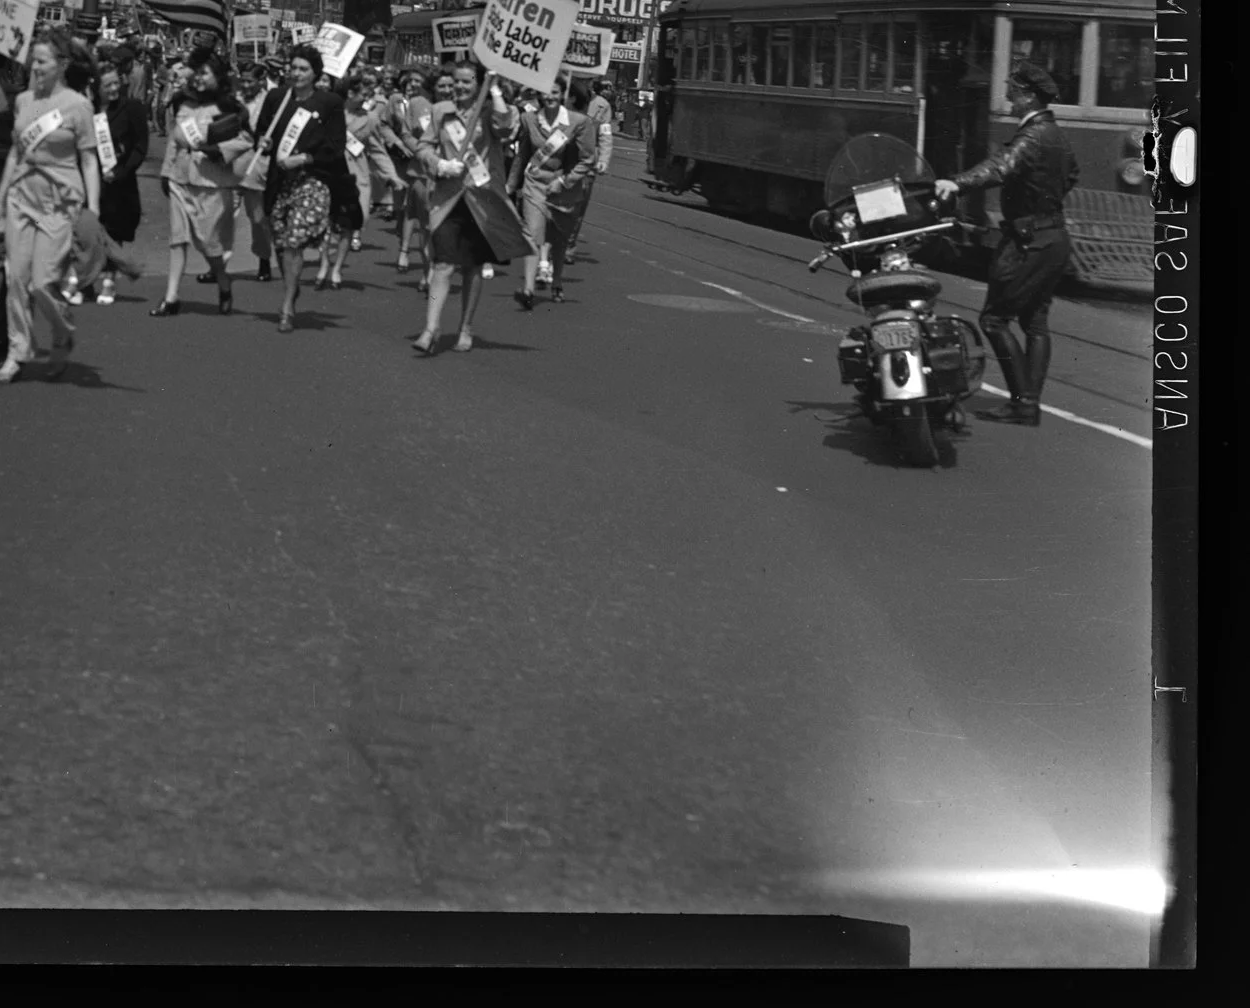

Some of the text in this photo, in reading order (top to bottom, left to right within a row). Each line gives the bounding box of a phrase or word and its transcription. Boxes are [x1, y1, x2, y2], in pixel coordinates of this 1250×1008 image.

[505, 19, 550, 52] Labor
[502, 40, 542, 72] Back
[611, 48, 639, 61] HOTEL
